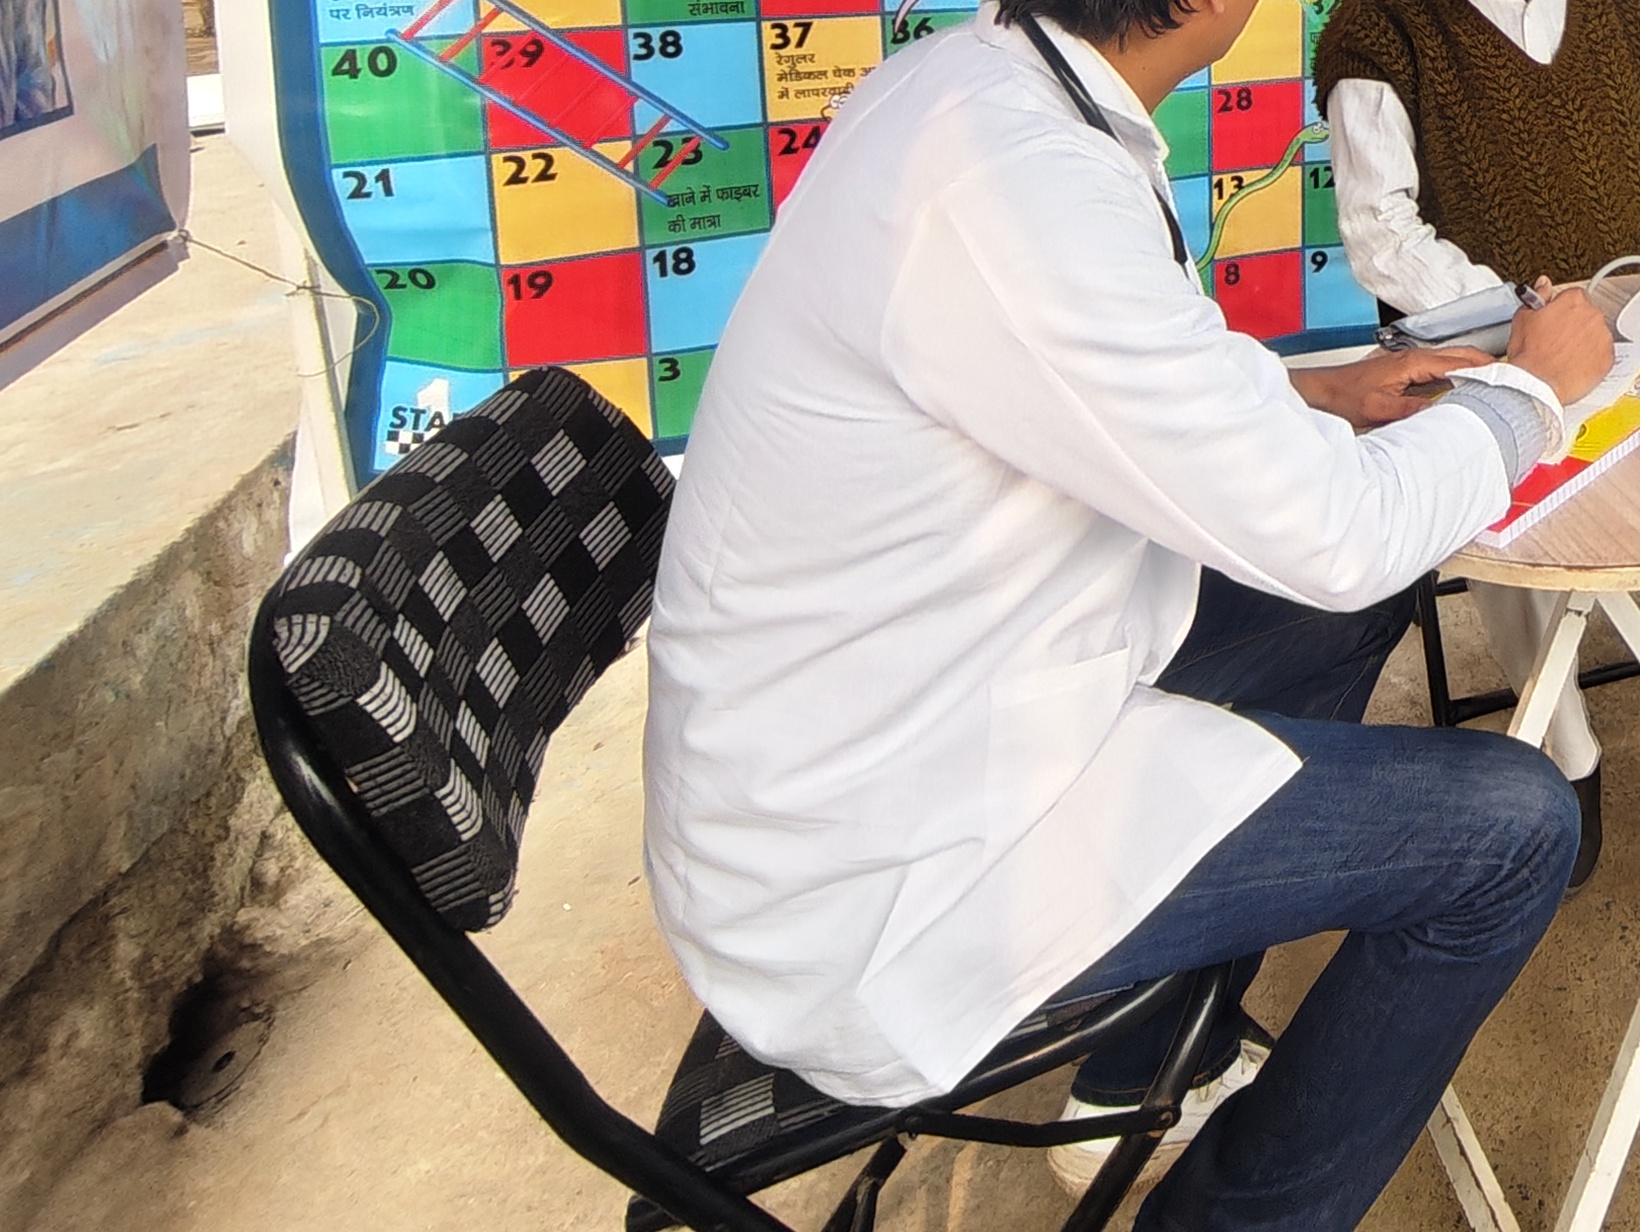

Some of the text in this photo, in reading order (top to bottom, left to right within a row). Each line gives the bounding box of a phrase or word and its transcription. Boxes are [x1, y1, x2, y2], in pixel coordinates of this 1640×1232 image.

[769, 21, 814, 50] 37
[331, 46, 397, 80] 40
[1217, 87, 1253, 113] 28
[342, 168, 394, 199] 21
[652, 247, 697, 278] 18
[1224, 264, 1241, 285] 8
[1310, 251, 1328, 273] 9
[375, 268, 436, 290] 20
[507, 270, 554, 301] 19
[658, 357, 681, 382] 3
[389, 406, 460, 430] STA
